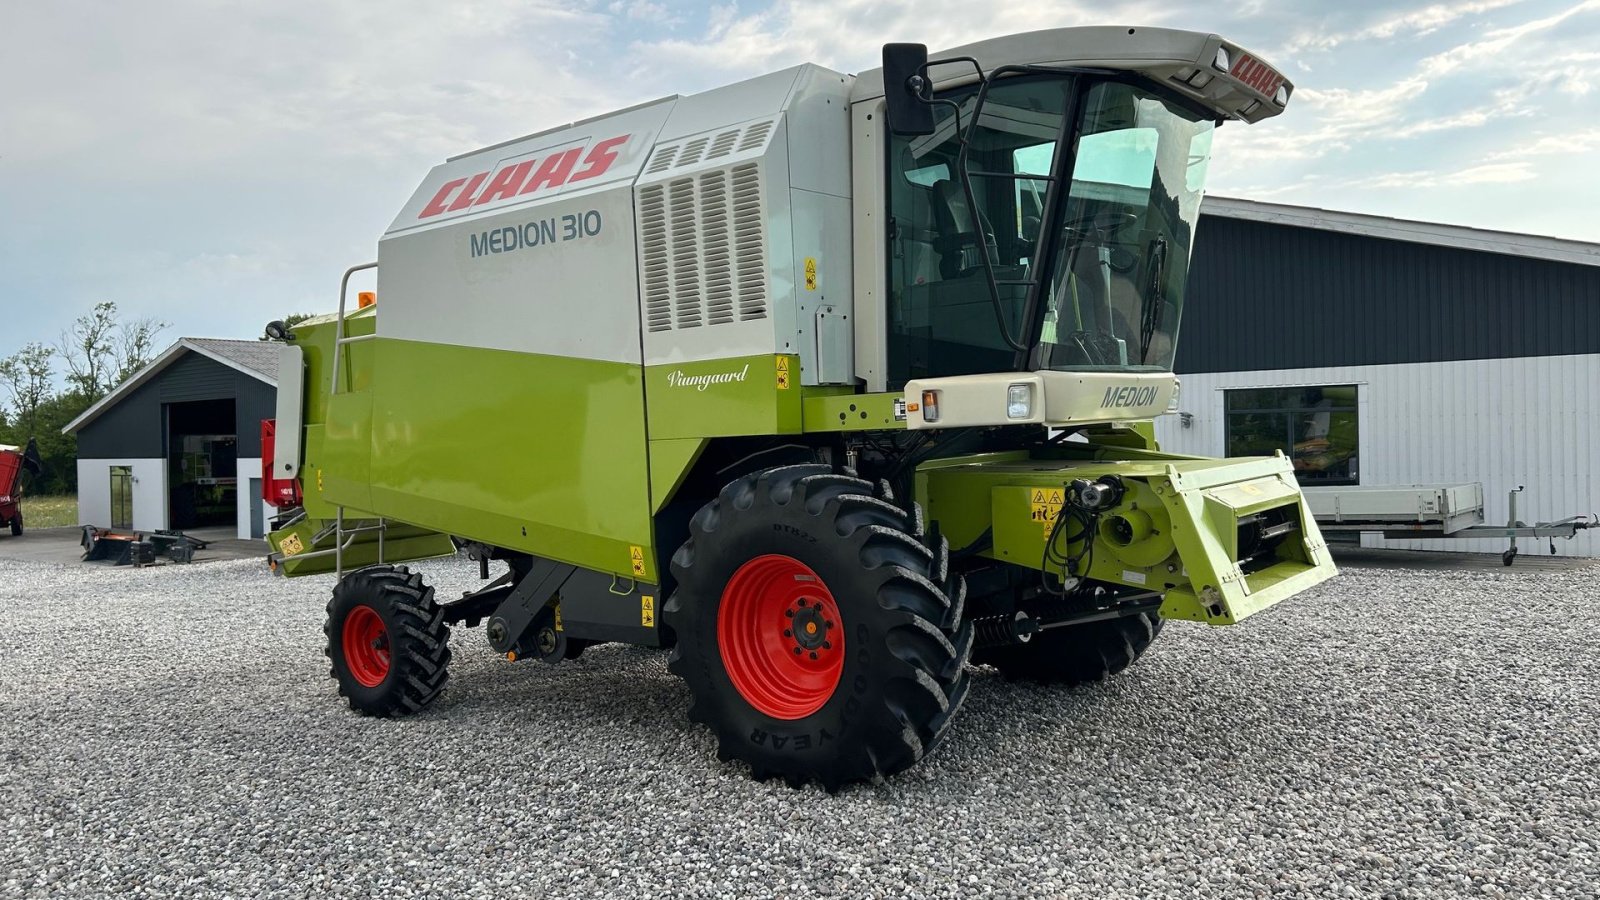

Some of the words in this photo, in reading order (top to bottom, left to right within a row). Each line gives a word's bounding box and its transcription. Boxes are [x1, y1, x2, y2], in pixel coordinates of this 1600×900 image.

[1230, 54, 1286, 98] CLAAS
[418, 133, 632, 219] CLAAS
[470, 217, 556, 258] MEDION
[562, 209, 602, 241] 310
[667, 364, 749, 391] Viumgaard
[1100, 386, 1159, 408] MEDION
